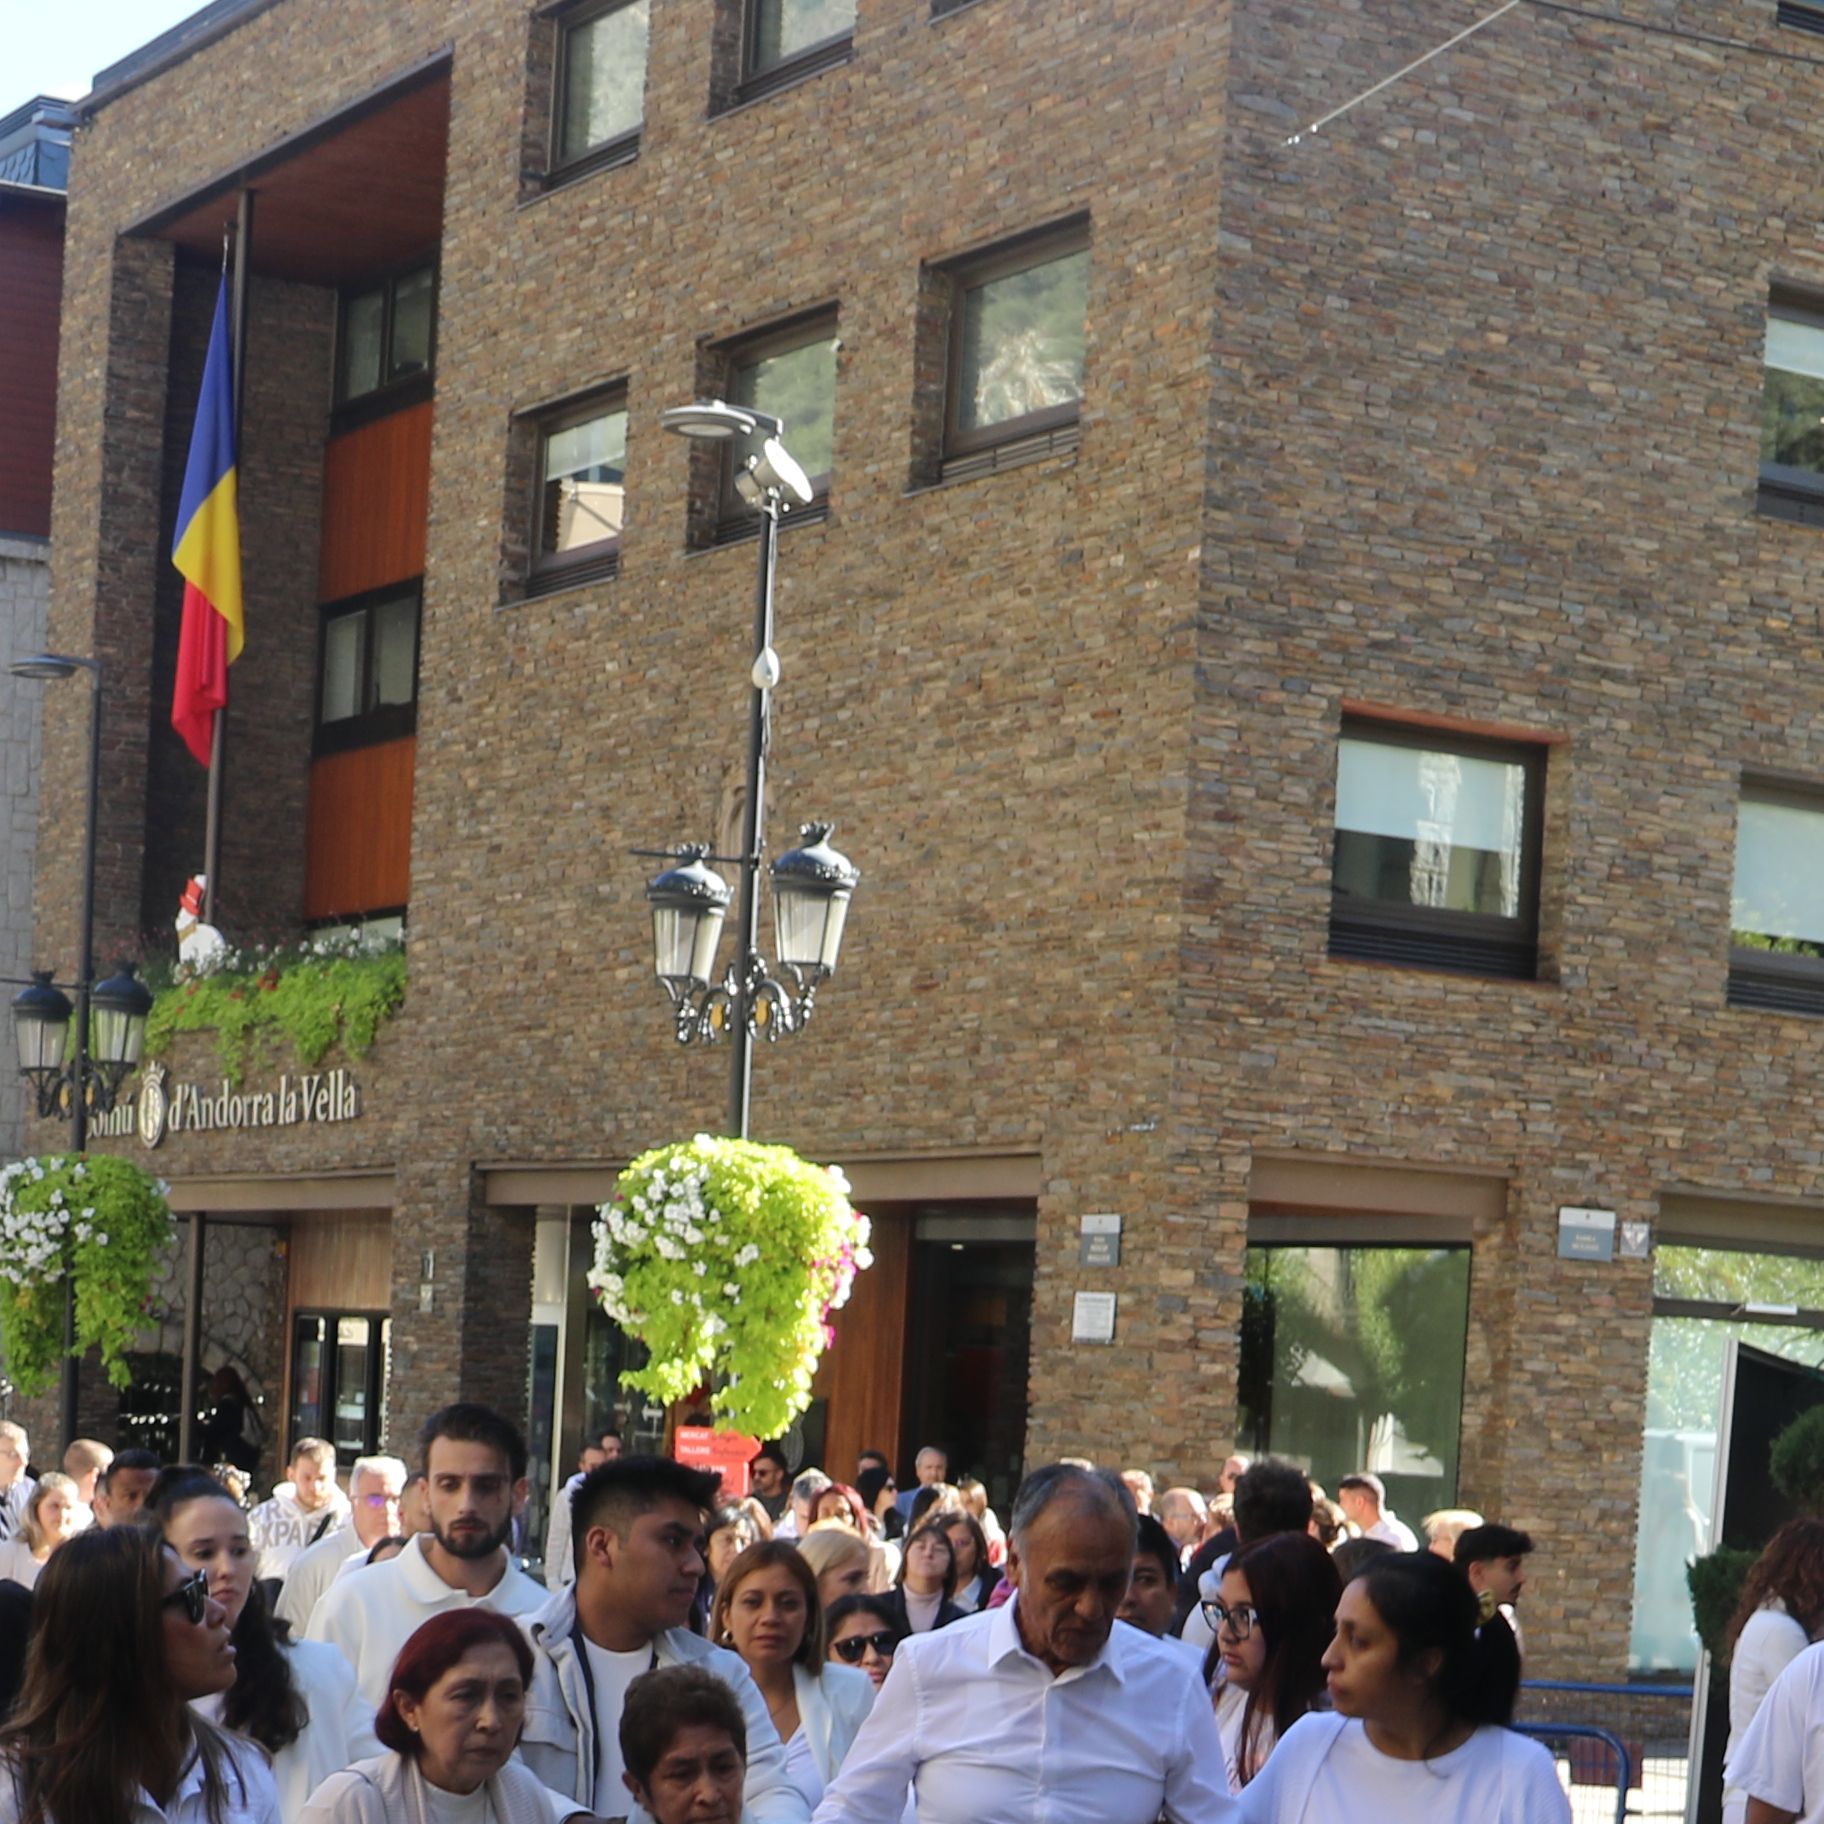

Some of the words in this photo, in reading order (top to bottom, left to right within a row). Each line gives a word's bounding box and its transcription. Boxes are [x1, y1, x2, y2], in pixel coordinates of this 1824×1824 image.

[168, 1077, 274, 1132] d'Andorra
[278, 1074, 297, 1125] la
[300, 1067, 357, 1122] Vella
